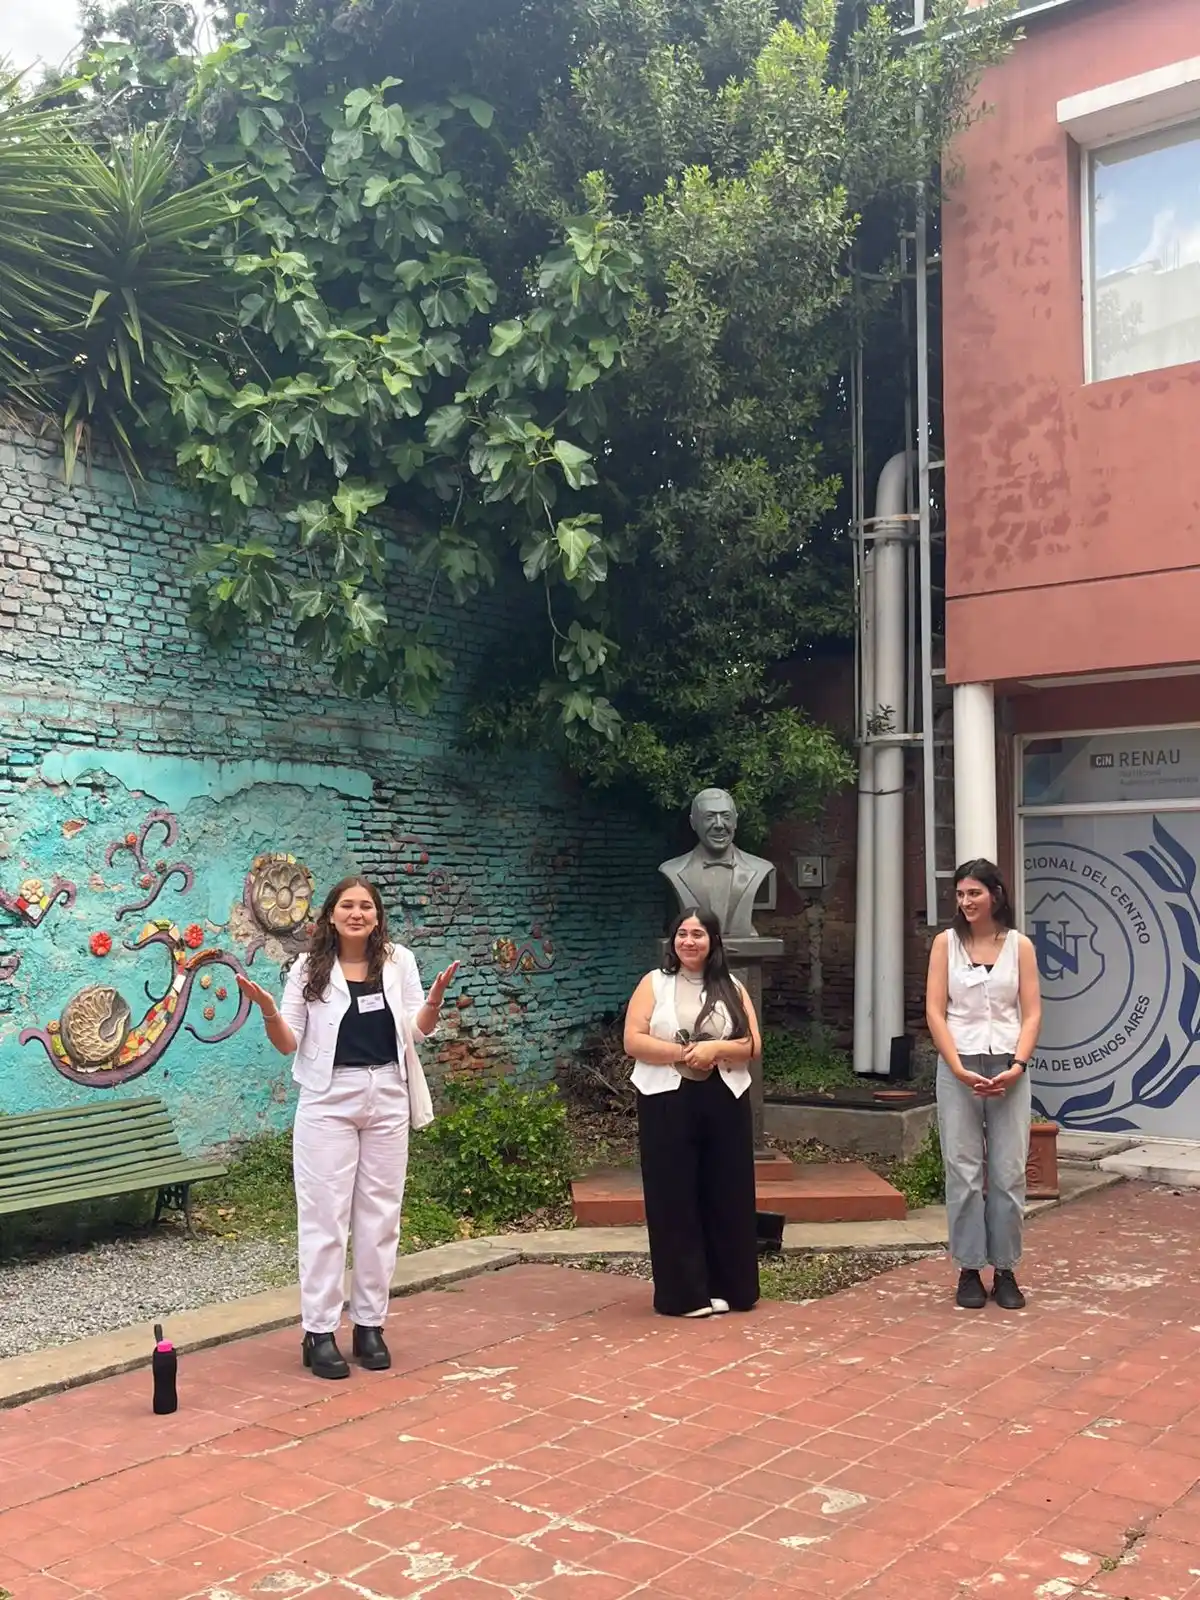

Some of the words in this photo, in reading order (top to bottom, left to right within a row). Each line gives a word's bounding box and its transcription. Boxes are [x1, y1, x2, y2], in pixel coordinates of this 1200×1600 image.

[1119, 749, 1180, 767] RENAU
[1081, 864, 1107, 889] DEL
[1110, 885, 1150, 944] CENTRO
[1052, 1059, 1071, 1071] DE
[1073, 1032, 1127, 1069] BUENOS
[1123, 995, 1150, 1037] AIRES
